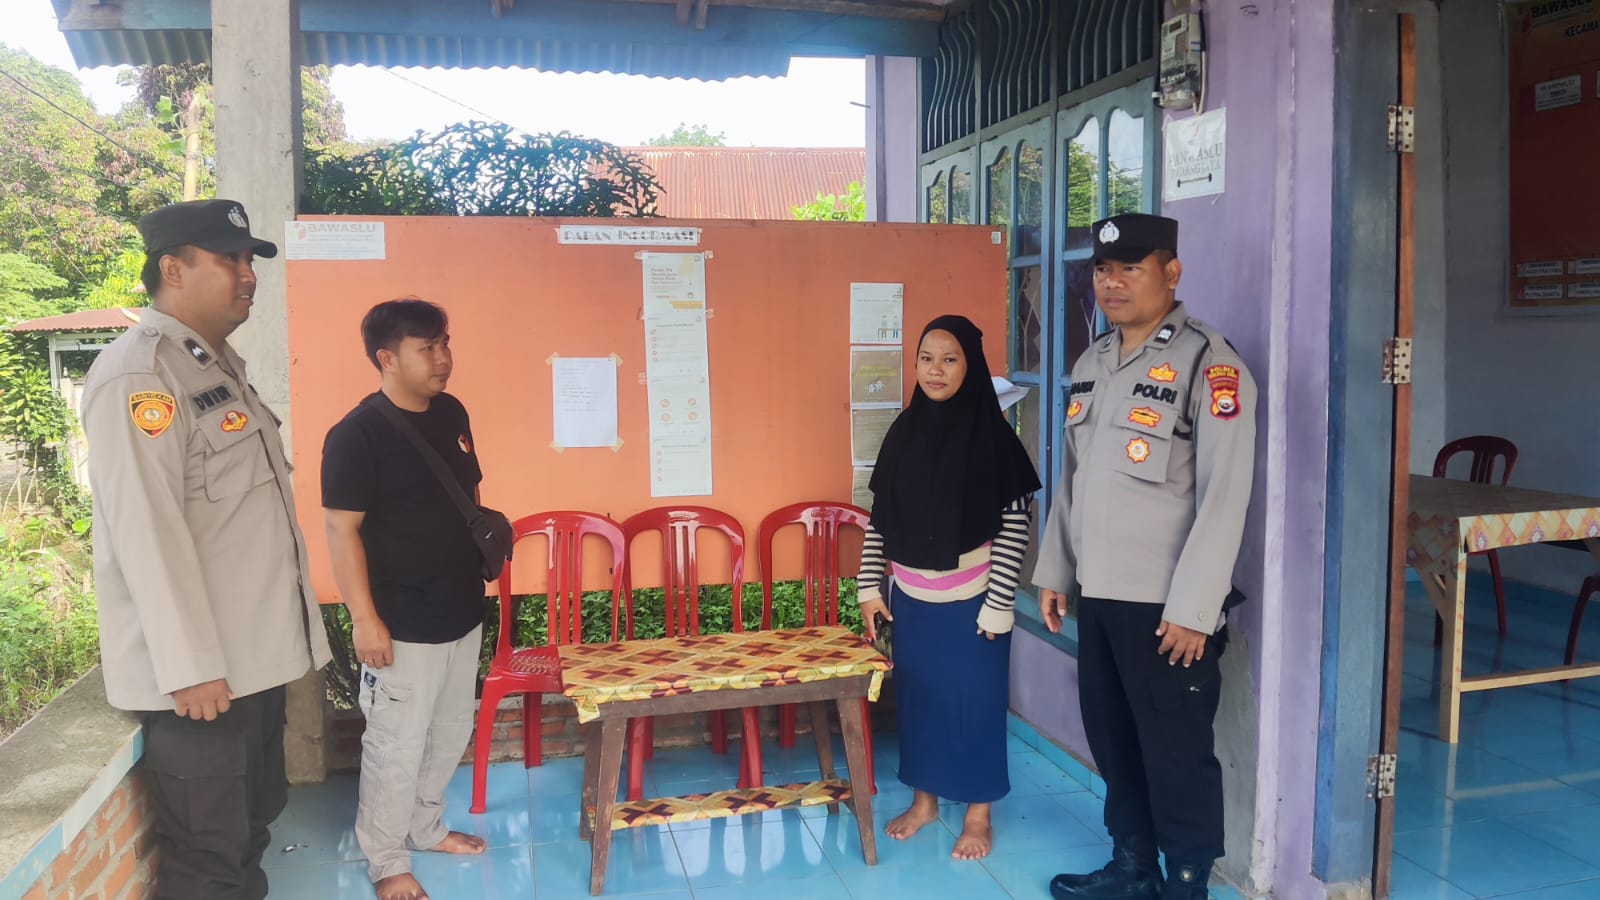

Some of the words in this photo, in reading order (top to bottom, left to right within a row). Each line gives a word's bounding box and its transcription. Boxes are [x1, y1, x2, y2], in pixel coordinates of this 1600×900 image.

[307, 223, 376, 233] BAWASLU
[563, 230, 611, 241] PAPAN
[617, 229, 694, 241] INFORMASI
[1132, 383, 1178, 404] POLRI
